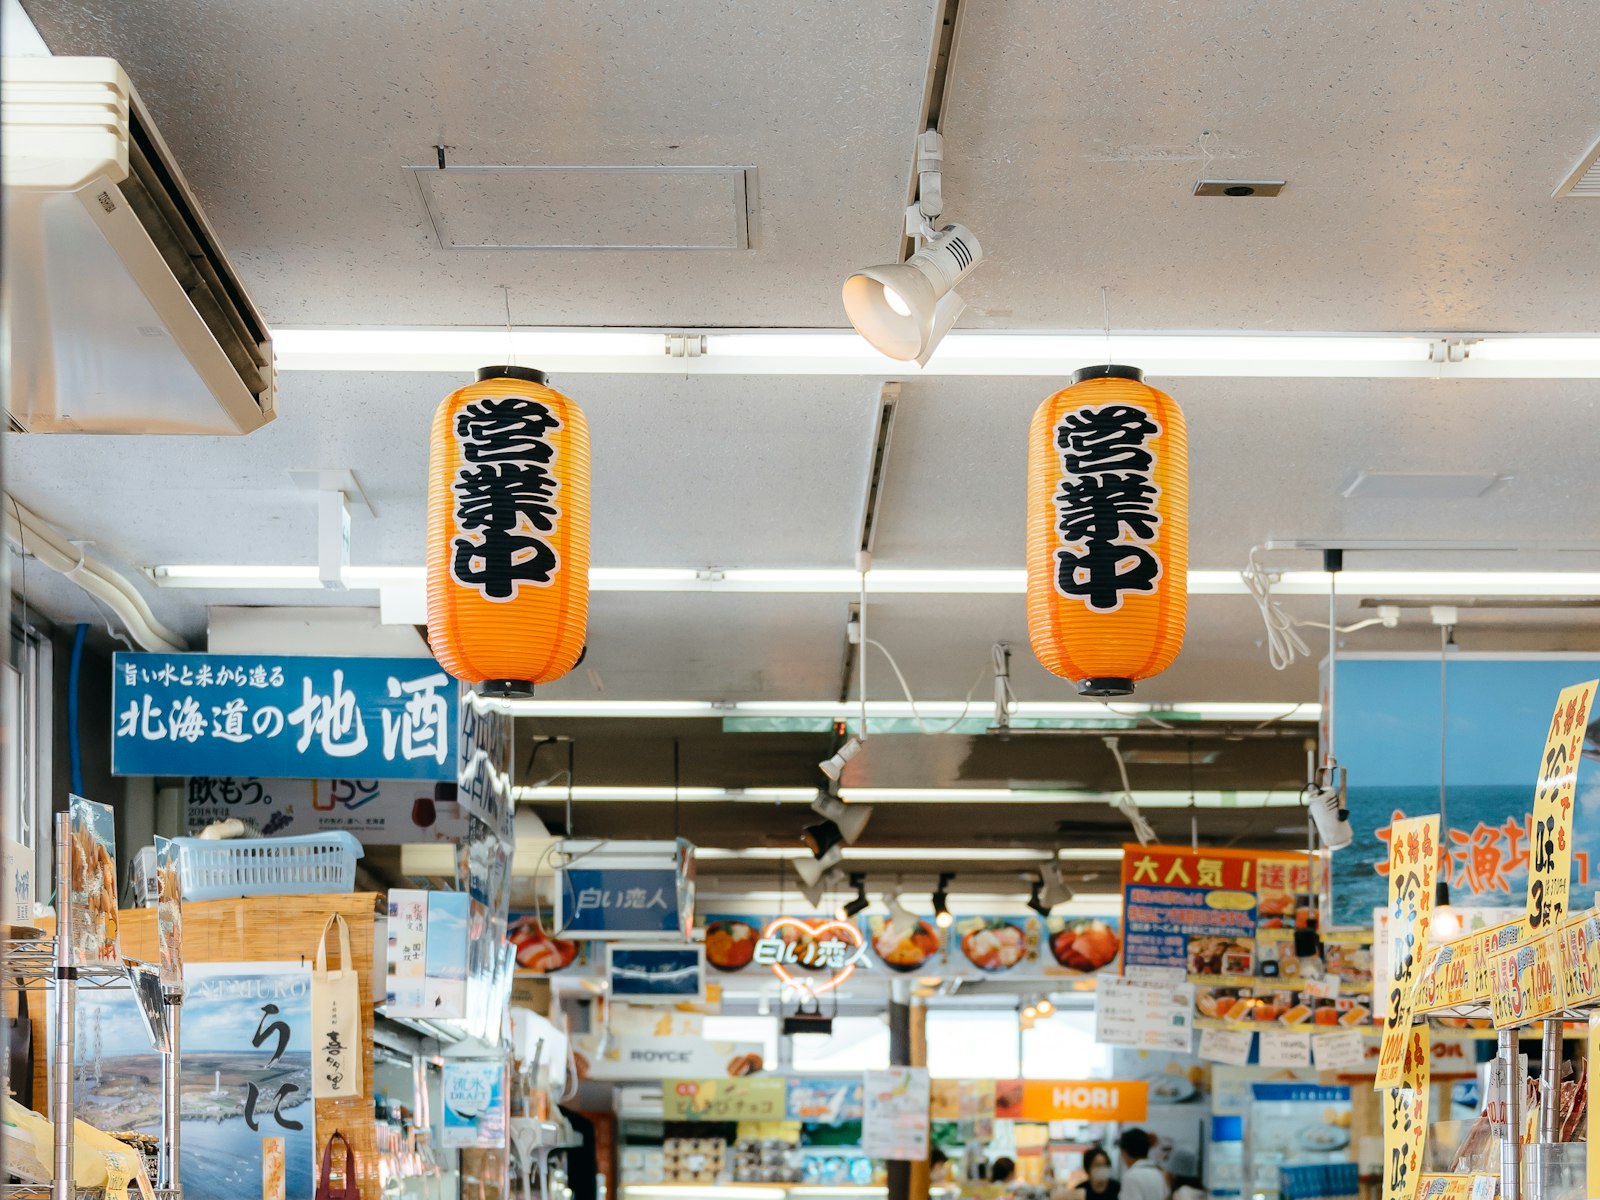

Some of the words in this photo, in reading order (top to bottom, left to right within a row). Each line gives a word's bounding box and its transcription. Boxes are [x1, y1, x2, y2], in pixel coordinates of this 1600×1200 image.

[454, 399, 560, 598] 営業中
[1055, 404, 1163, 610] 営業中
[125, 662, 285, 688] 旨い水と米から造る
[188, 776, 272, 806] 飲もう。
[1133, 855, 1250, 888] 大人気！
[577, 887, 668, 910] 白い恋人
[753, 935, 874, 969] 白い恋人
[244, 1003, 304, 1132] うに
[1052, 1087, 1119, 1110] HORI
